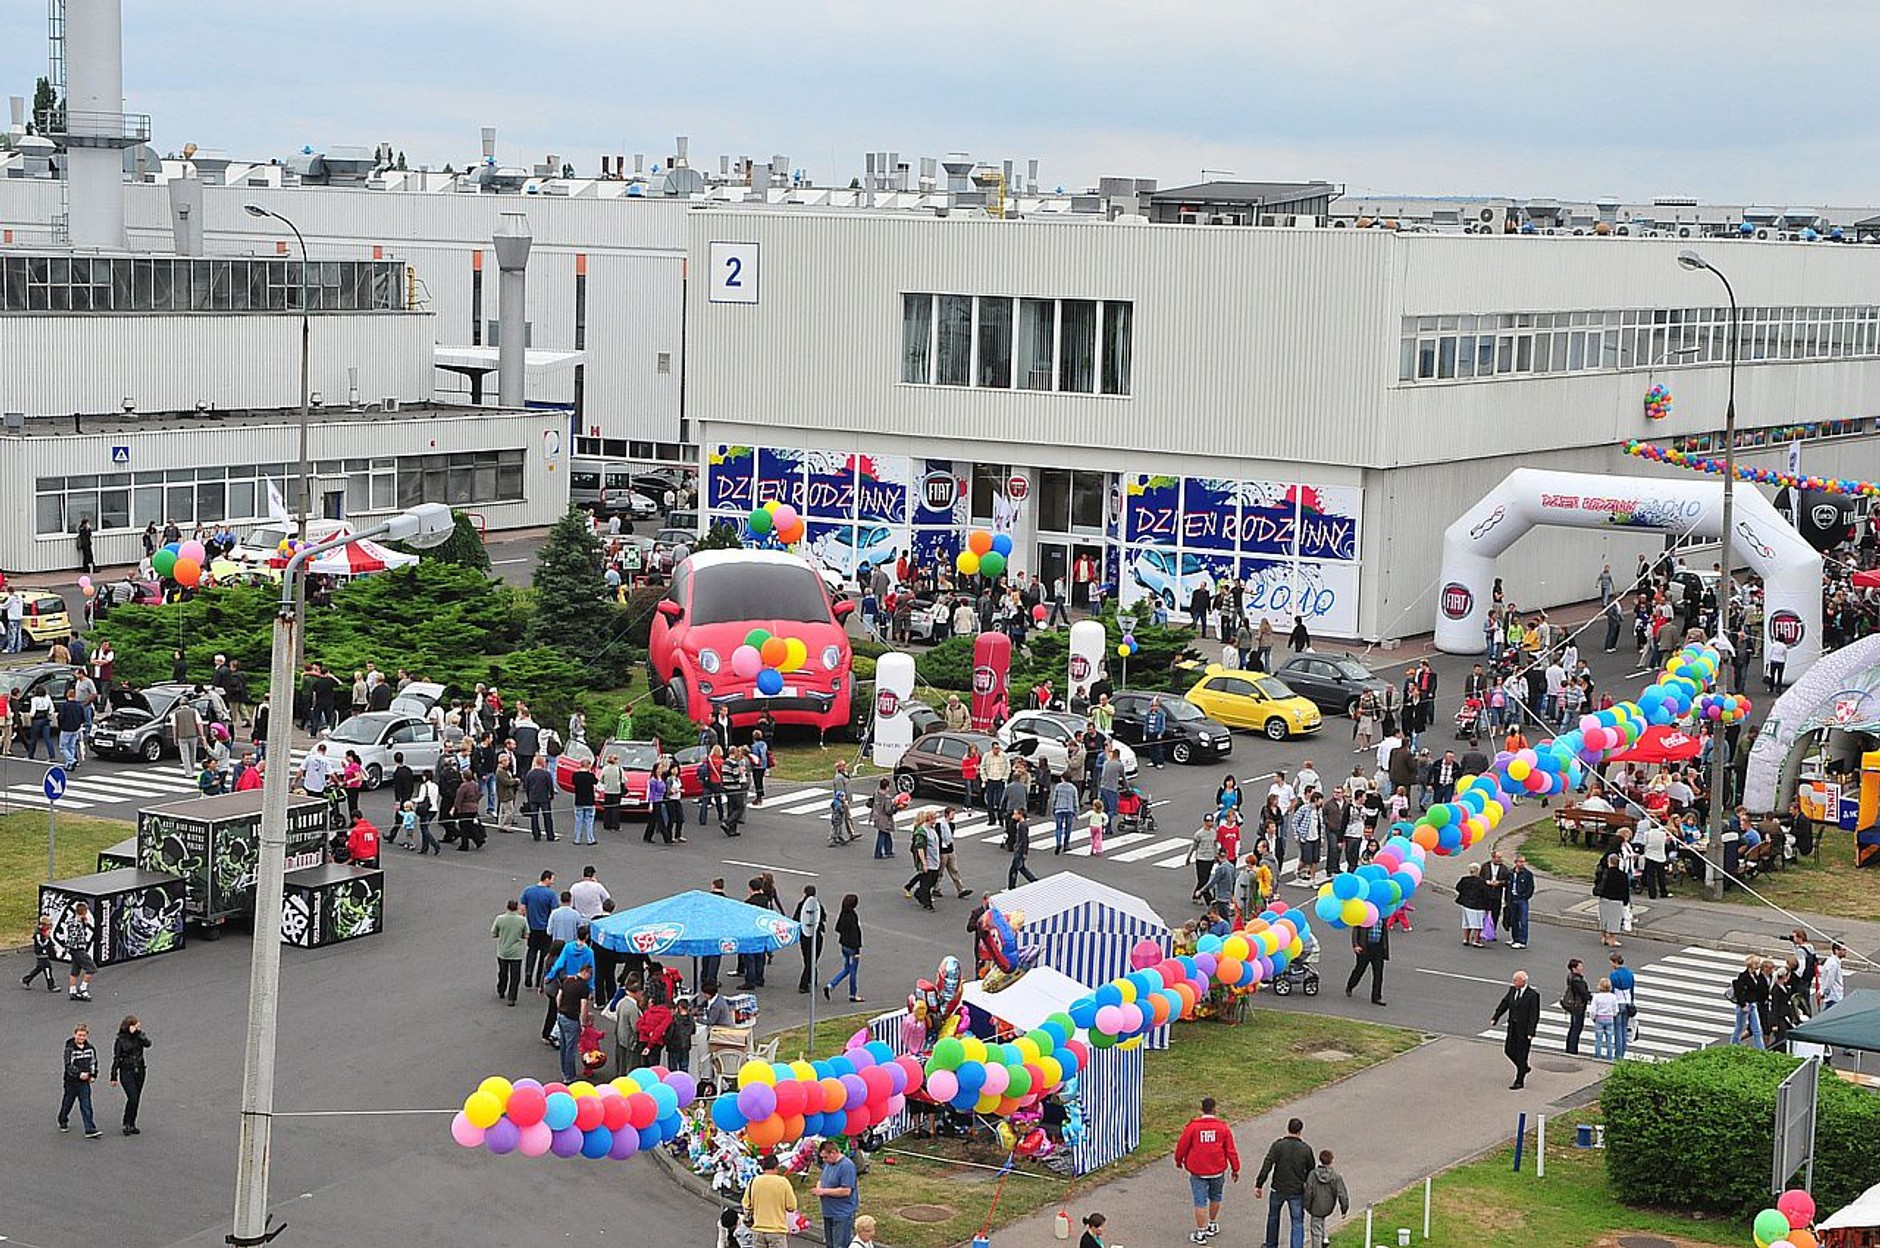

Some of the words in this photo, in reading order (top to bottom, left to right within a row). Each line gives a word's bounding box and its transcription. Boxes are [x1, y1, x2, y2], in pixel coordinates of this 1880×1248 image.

[725, 256, 742, 286] 2
[928, 482, 952, 501] FIAT
[1245, 584, 1336, 616] 2010
[1445, 593, 1467, 611] FIAT
[1775, 621, 1797, 639] FIAT
